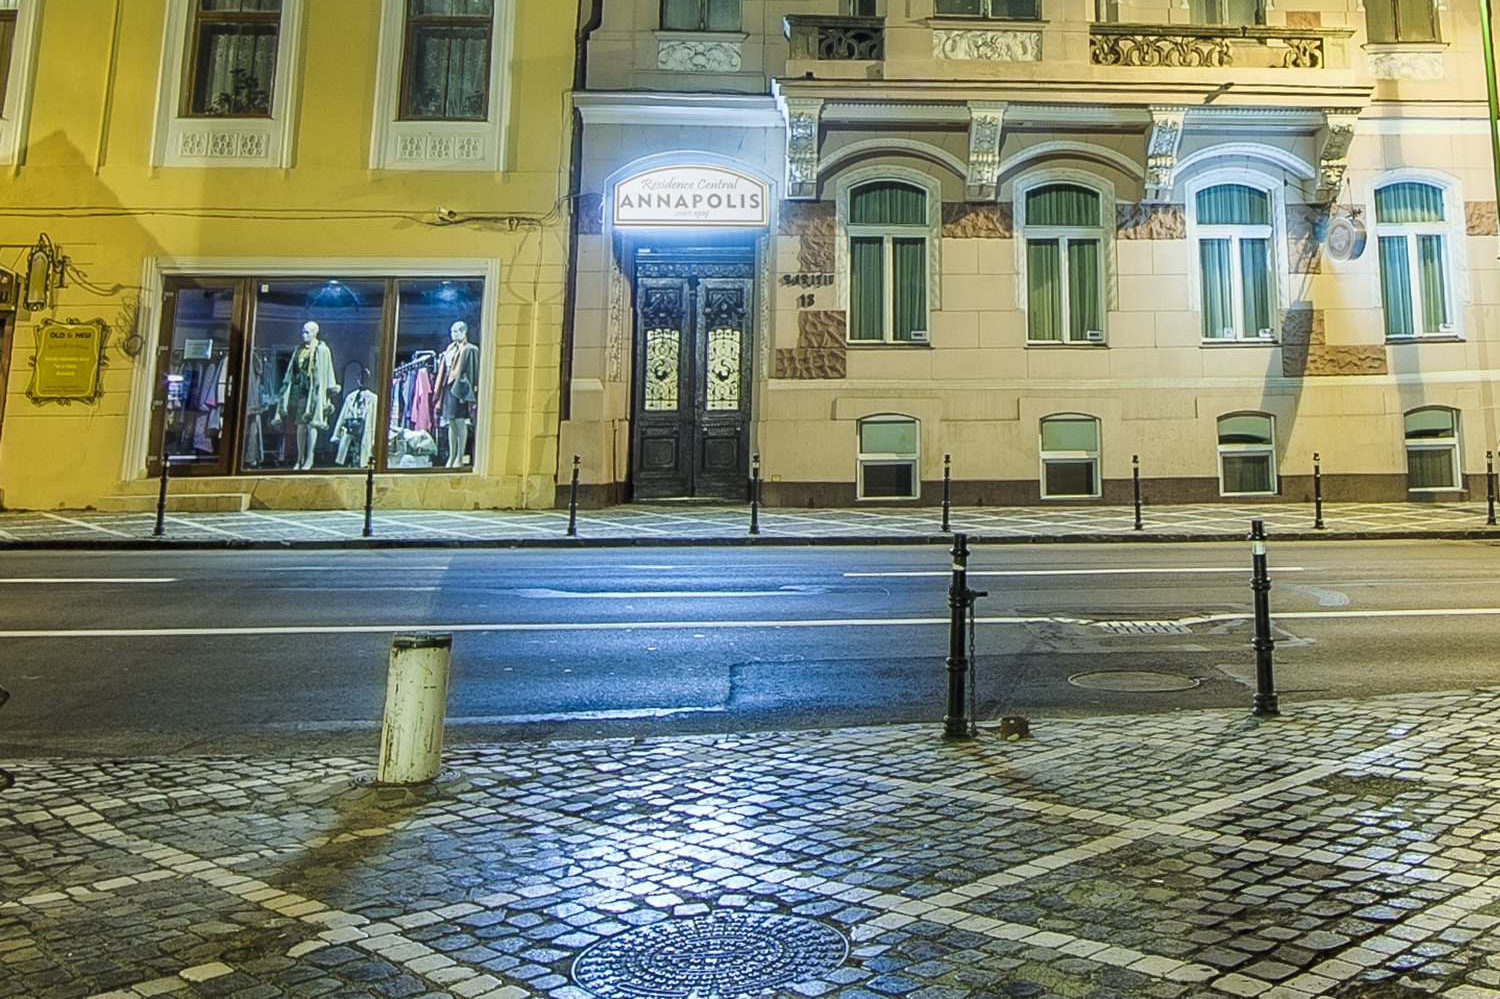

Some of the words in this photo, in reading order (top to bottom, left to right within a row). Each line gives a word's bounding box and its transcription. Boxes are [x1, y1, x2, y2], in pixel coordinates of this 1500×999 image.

[641, 176, 694, 191] Residence
[697, 177, 739, 190] Central
[619, 193, 760, 209] ANNAPOLIS
